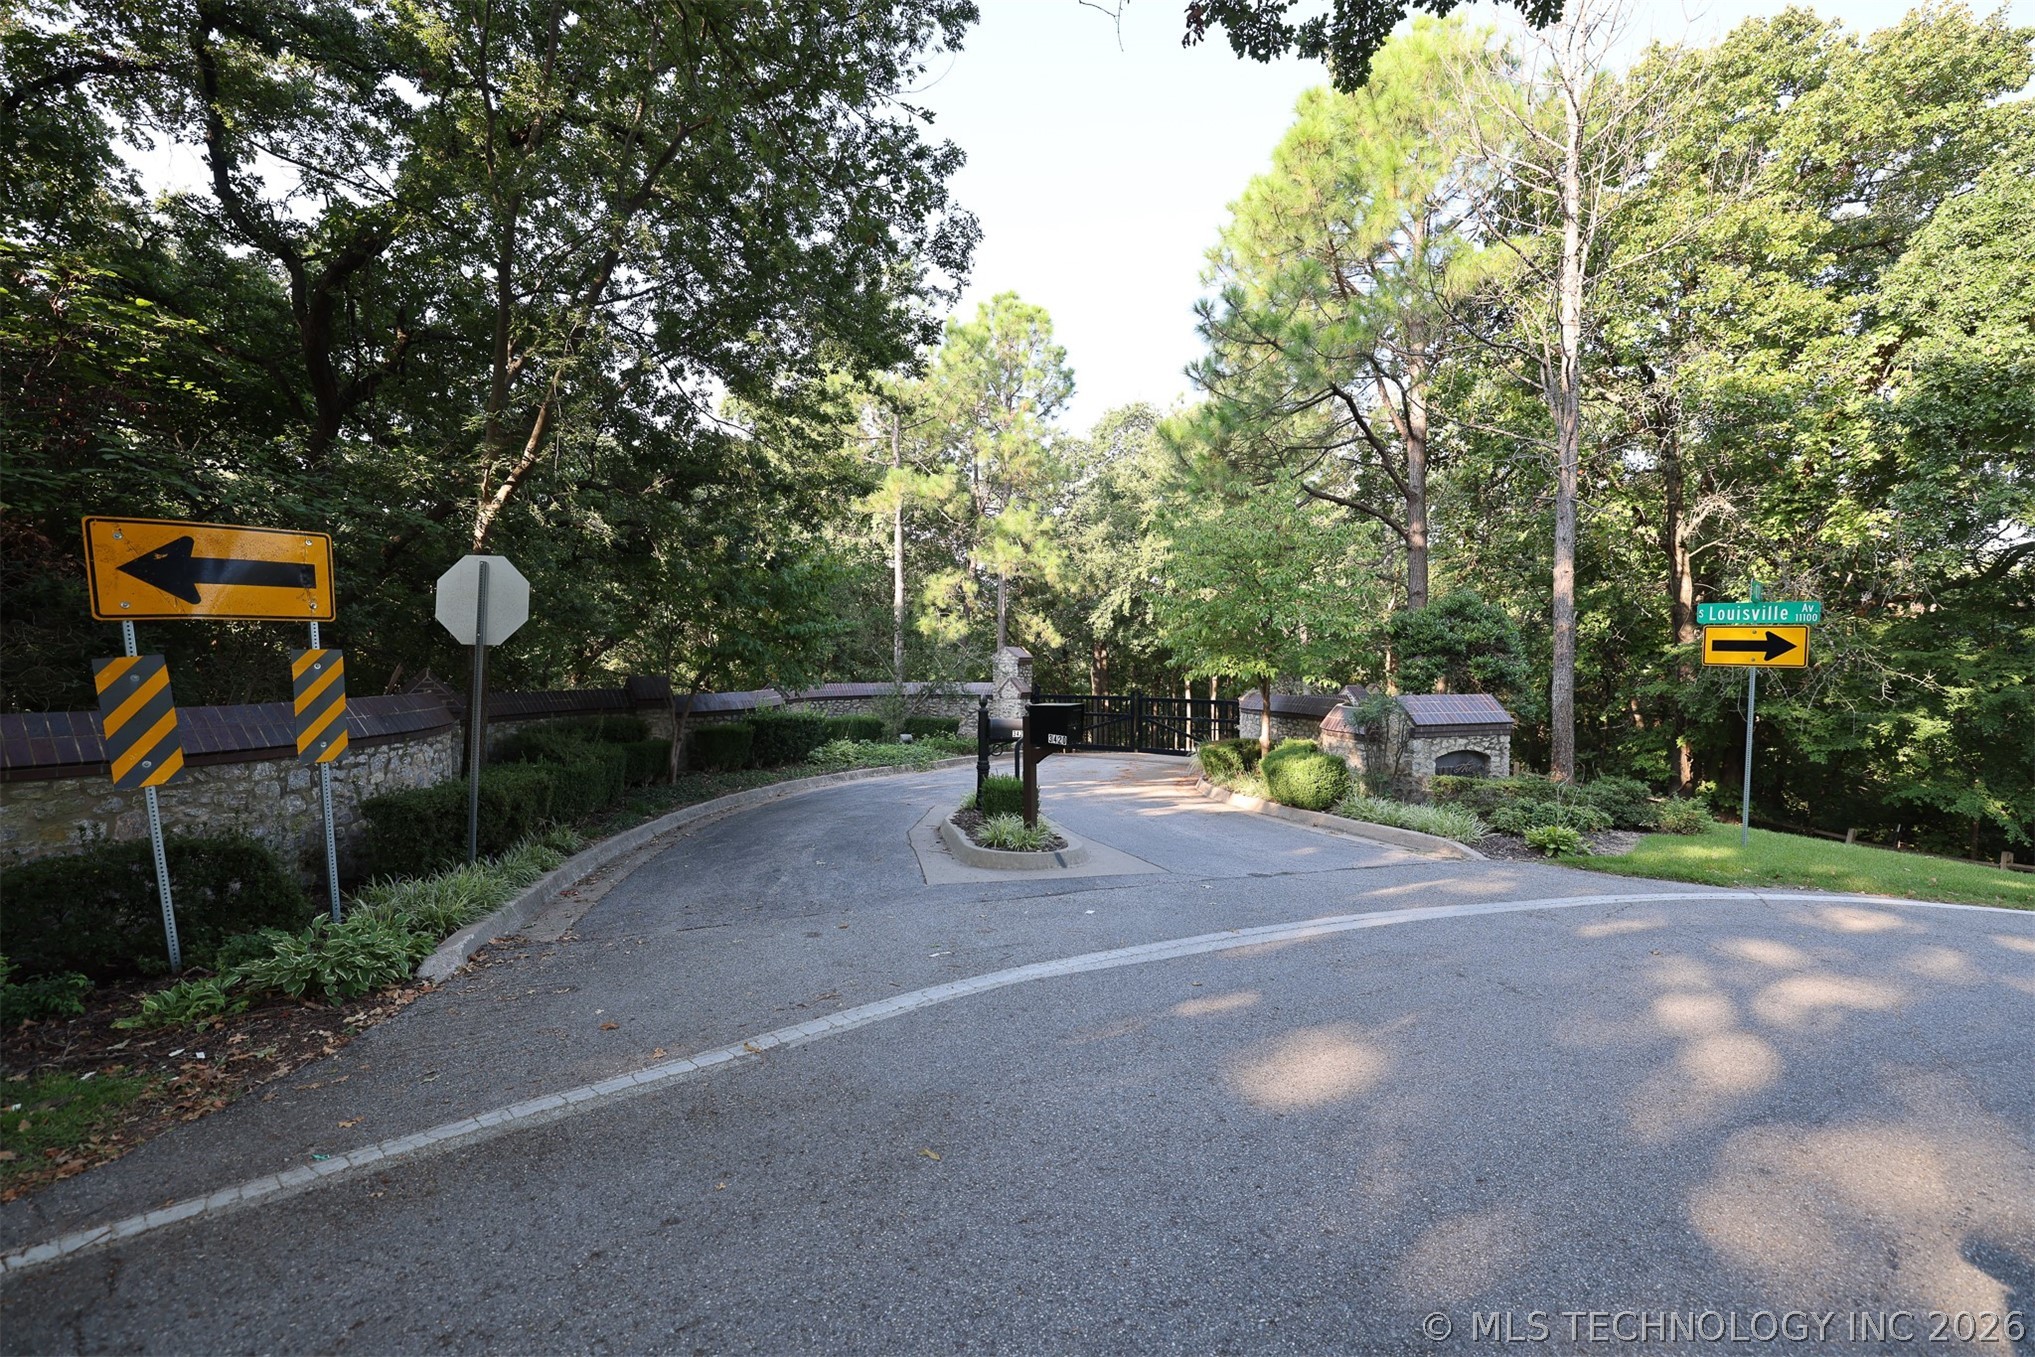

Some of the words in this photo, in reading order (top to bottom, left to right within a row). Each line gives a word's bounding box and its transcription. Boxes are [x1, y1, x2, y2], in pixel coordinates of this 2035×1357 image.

[1698, 609, 1704, 618] S
[1709, 605, 1789, 621] Louisville
[1795, 613, 1818, 622] 11100
